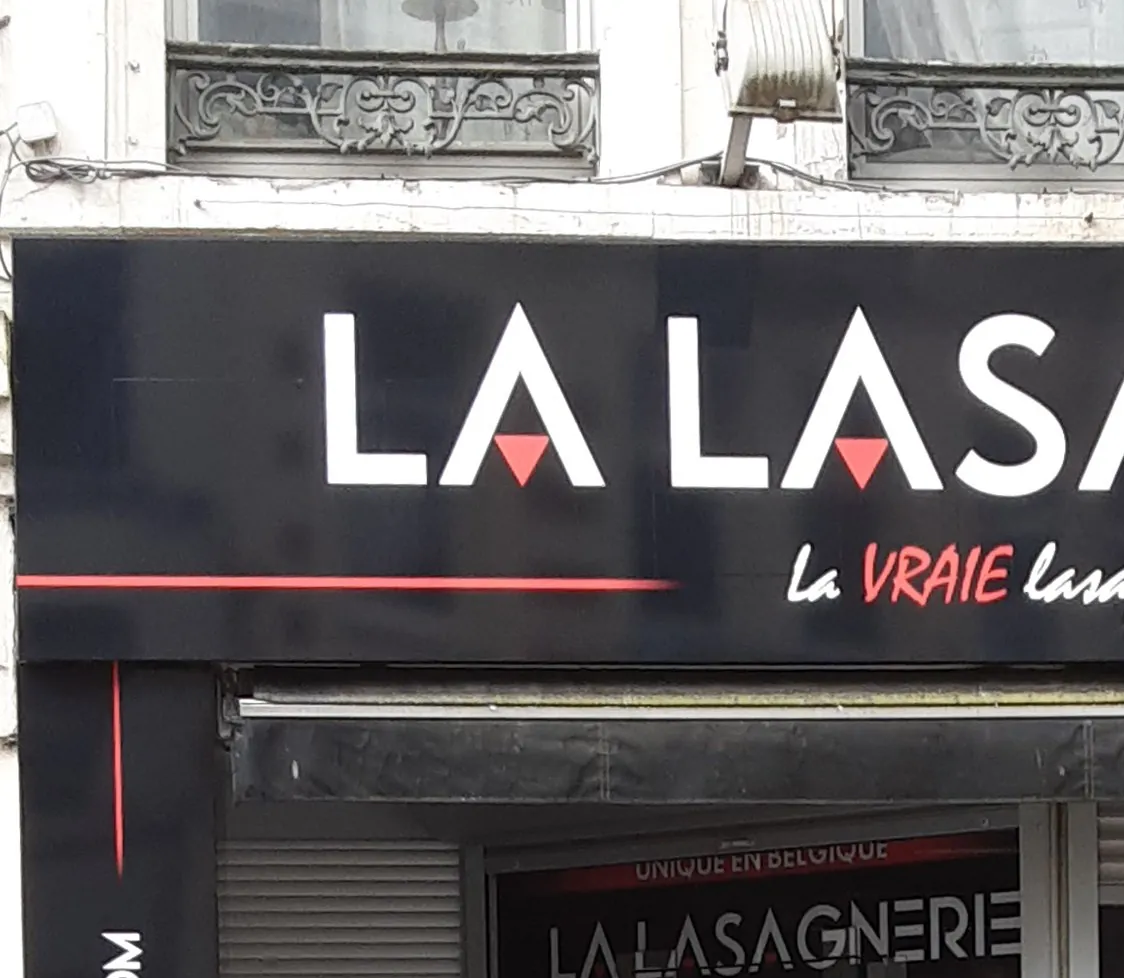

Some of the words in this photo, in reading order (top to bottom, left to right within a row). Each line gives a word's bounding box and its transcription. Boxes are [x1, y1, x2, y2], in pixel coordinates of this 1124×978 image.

[323, 302, 606, 487] LA
[787, 544, 840, 604] La
[862, 544, 1014, 608] VRAIE
